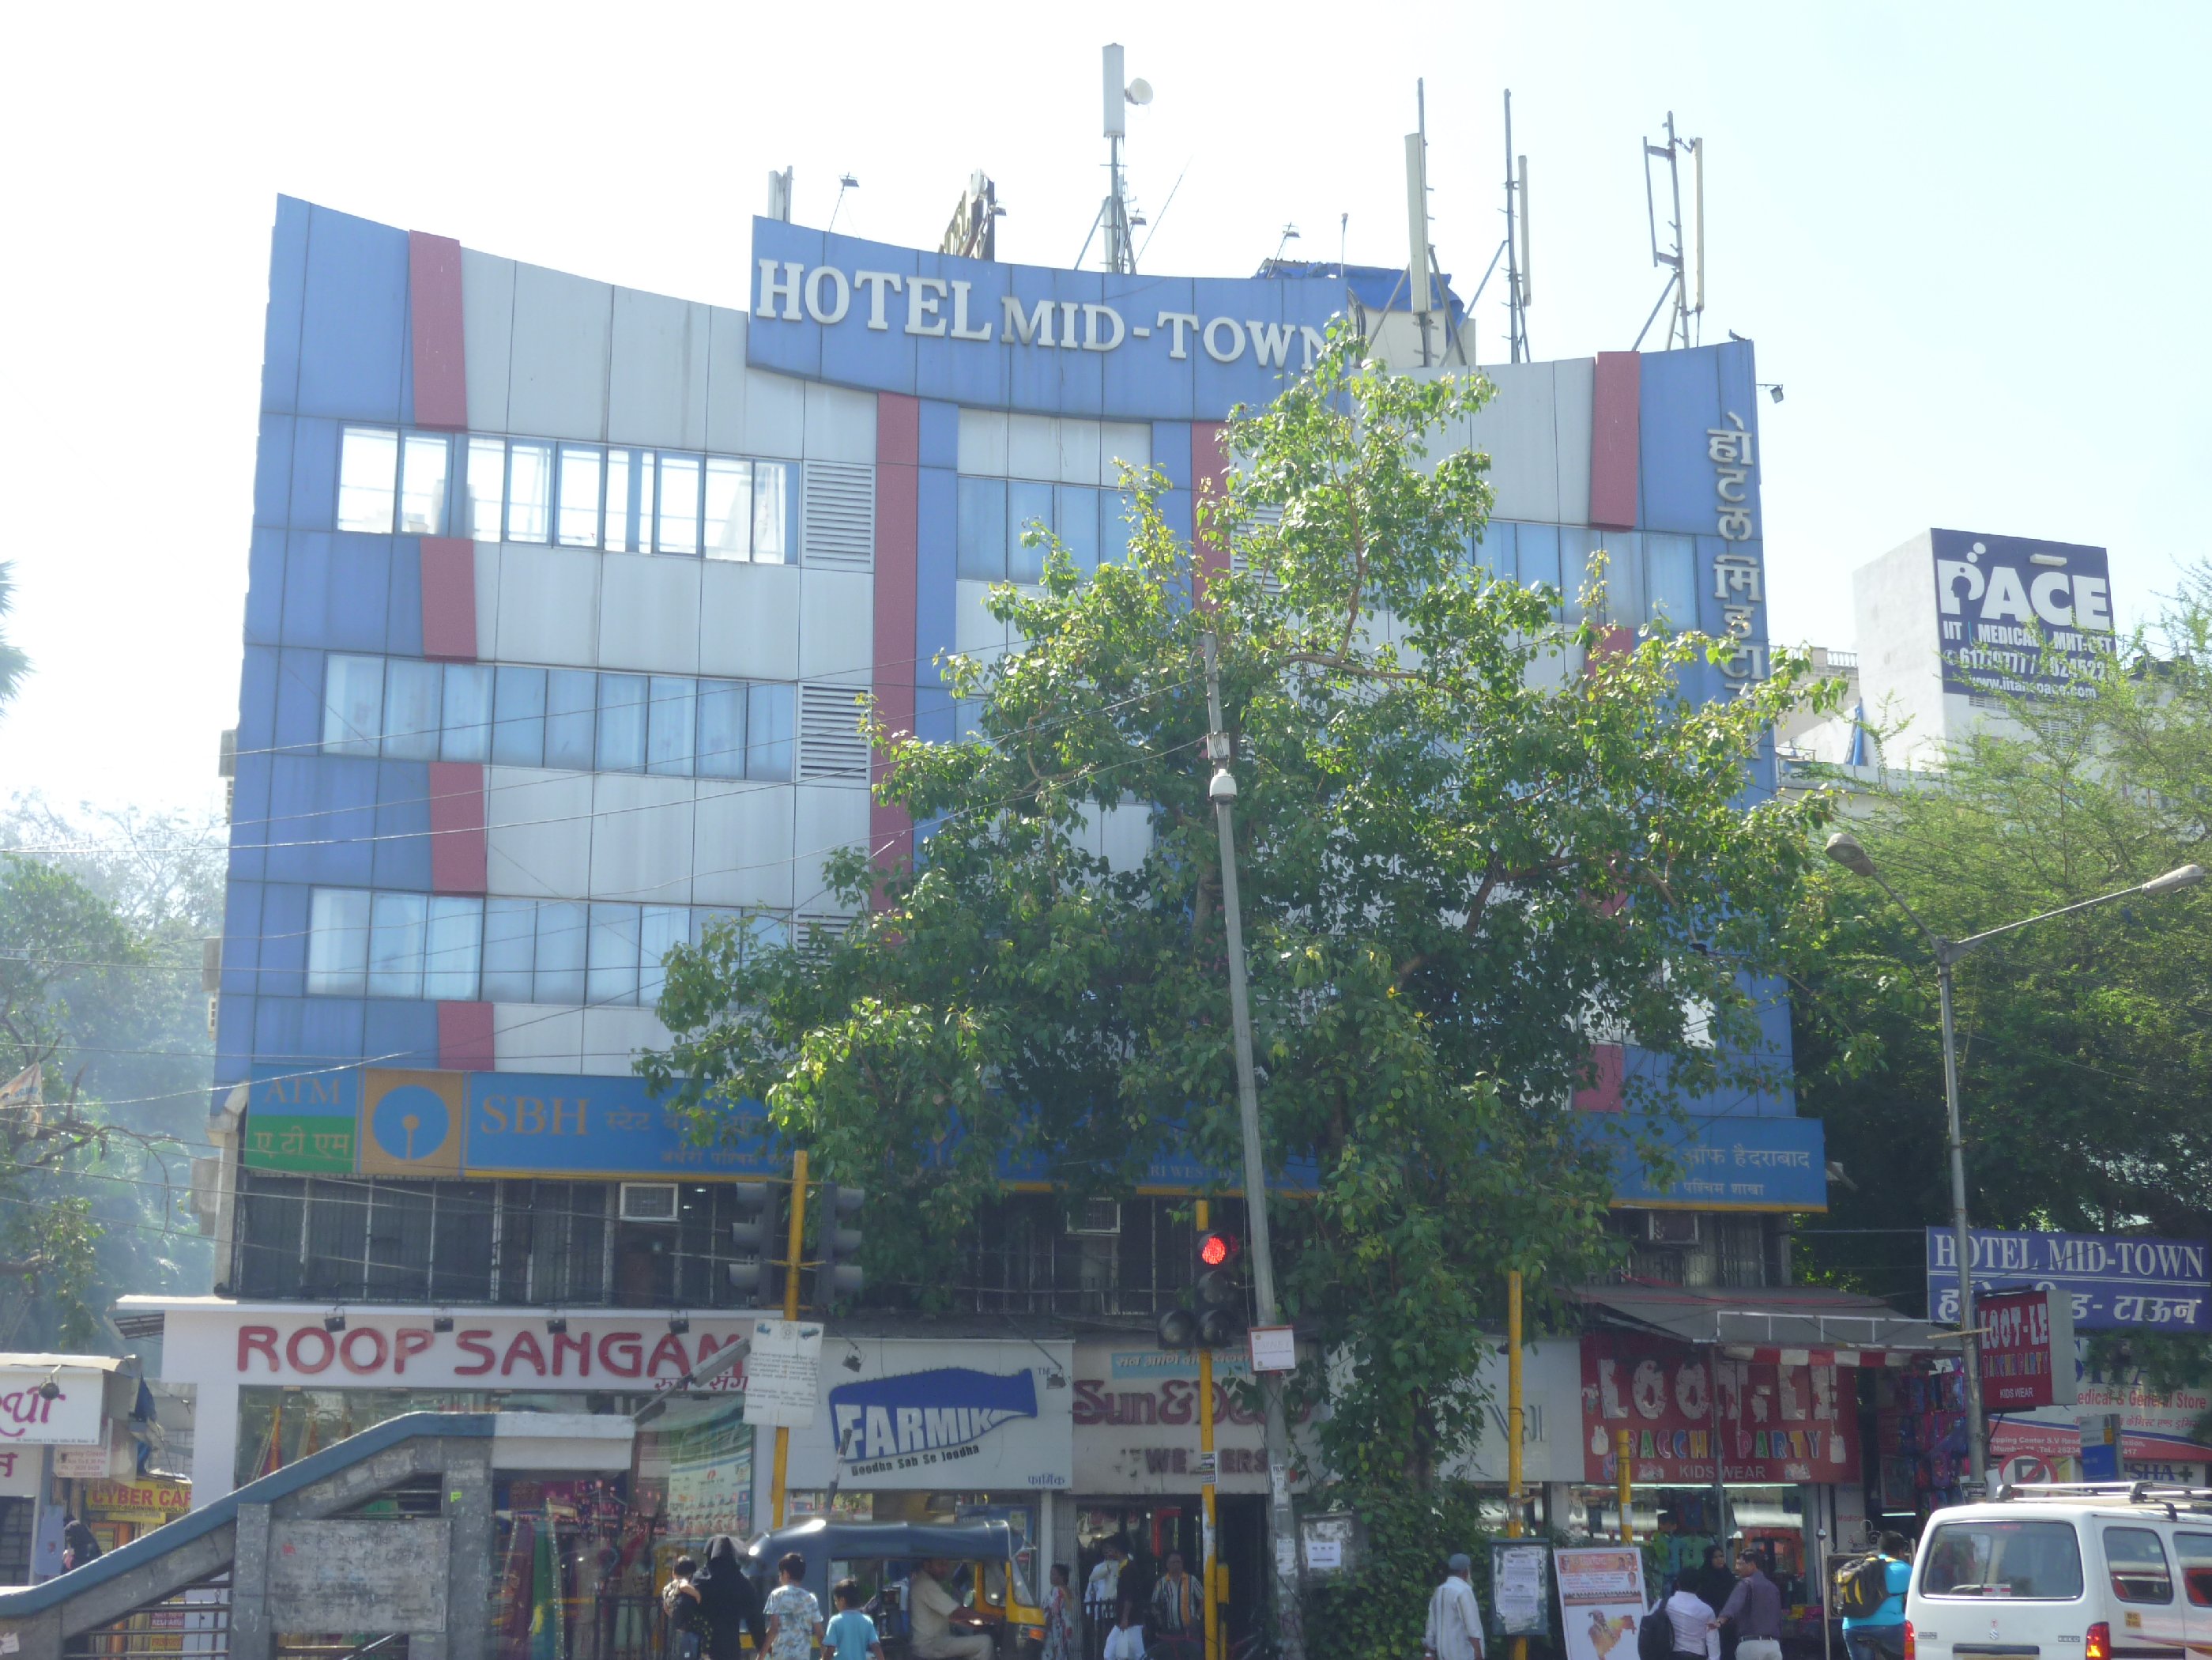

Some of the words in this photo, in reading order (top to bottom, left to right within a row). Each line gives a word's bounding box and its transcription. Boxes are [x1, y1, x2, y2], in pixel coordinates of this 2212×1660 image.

[755, 258, 992, 341] HOTEL
[1000, 296, 1341, 372] MID-TOWN
[1705, 410, 1754, 541] होटल
[1937, 558, 2112, 632] PACE
[1942, 621, 1963, 640] IIT
[1977, 624, 2040, 648] MEDICAL
[265, 1077, 341, 1105] ATM
[480, 1094, 591, 1136] SBH
[1733, 1143, 1810, 1168] हैदराबाद
[2048, 1239, 2204, 1278] MID-TOWN
[1980, 1303, 2048, 1349] LOOT-LE
[238, 1326, 434, 1375] ROOP
[454, 1330, 744, 1379] SANGAM
[1597, 1358, 1838, 1421] LOOT-LE
[1999, 1388, 2014, 1398] KIDS
[2014, 1387, 2033, 1398] WEAR
[2076, 1388, 2112, 1405] edical
[2176, 1393, 2206, 1409] Store
[835, 1403, 1030, 1461] FARMIK
[1737, 1430, 1821, 1458] PARTY
[1990, 1437, 2018, 1446] opping
[1679, 1464, 1715, 1479] KIDS
[1721, 1465, 1766, 1479] WEAR
[2124, 1462, 2176, 1482] SHA
[92, 1485, 153, 1507] CYBER
[159, 1489, 191, 1509] CAF
